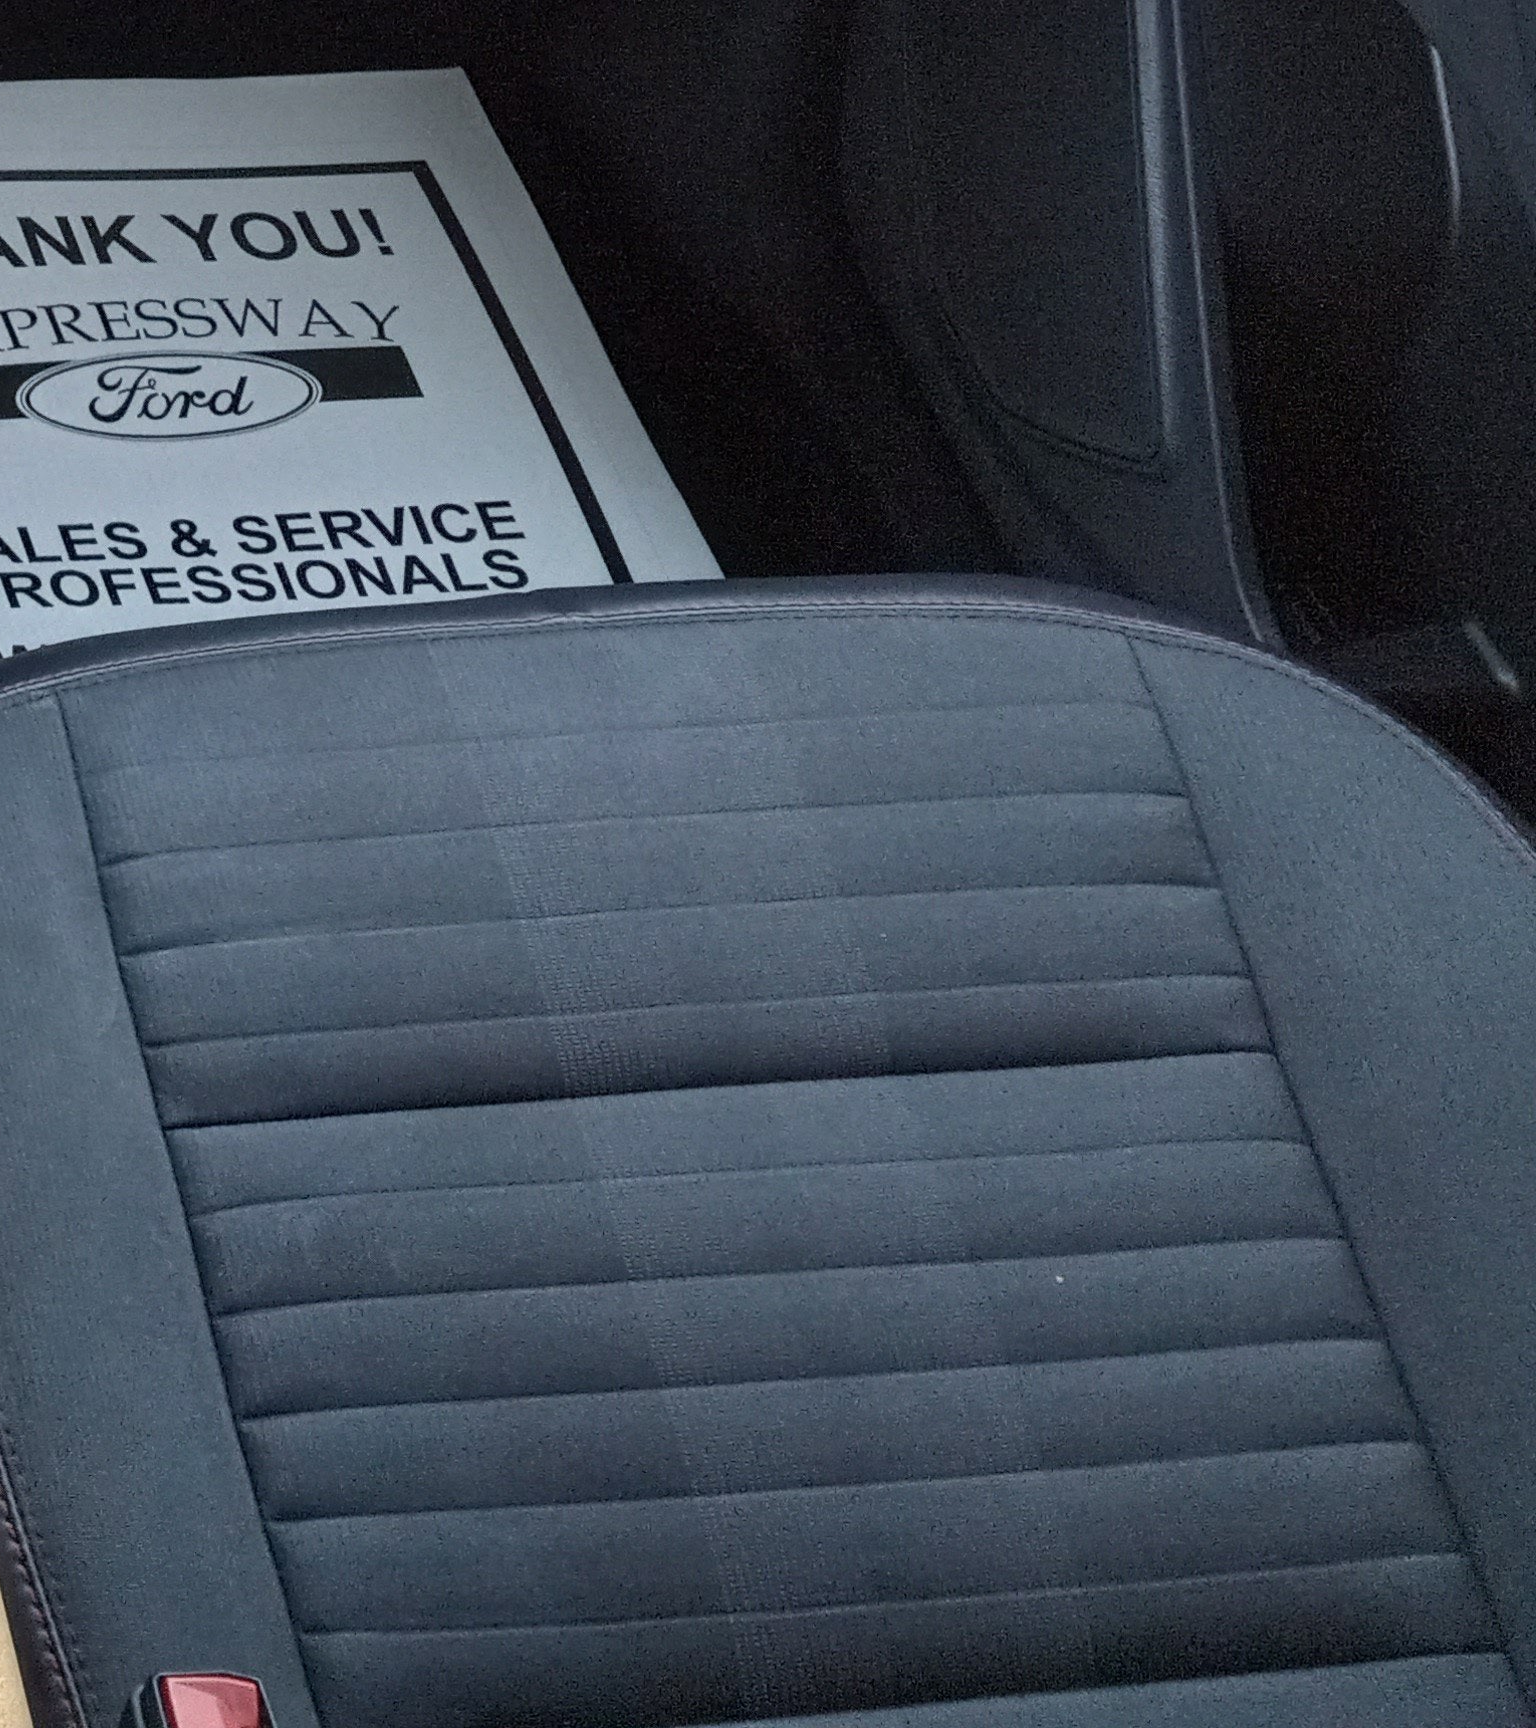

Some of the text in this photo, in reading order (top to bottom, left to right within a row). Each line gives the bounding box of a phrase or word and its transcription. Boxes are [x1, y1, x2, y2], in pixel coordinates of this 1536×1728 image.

[160, 208, 395, 263] YOU!
[88, 364, 254, 424] Ford
[169, 518, 218, 558] &
[232, 500, 526, 555] SERVICE
